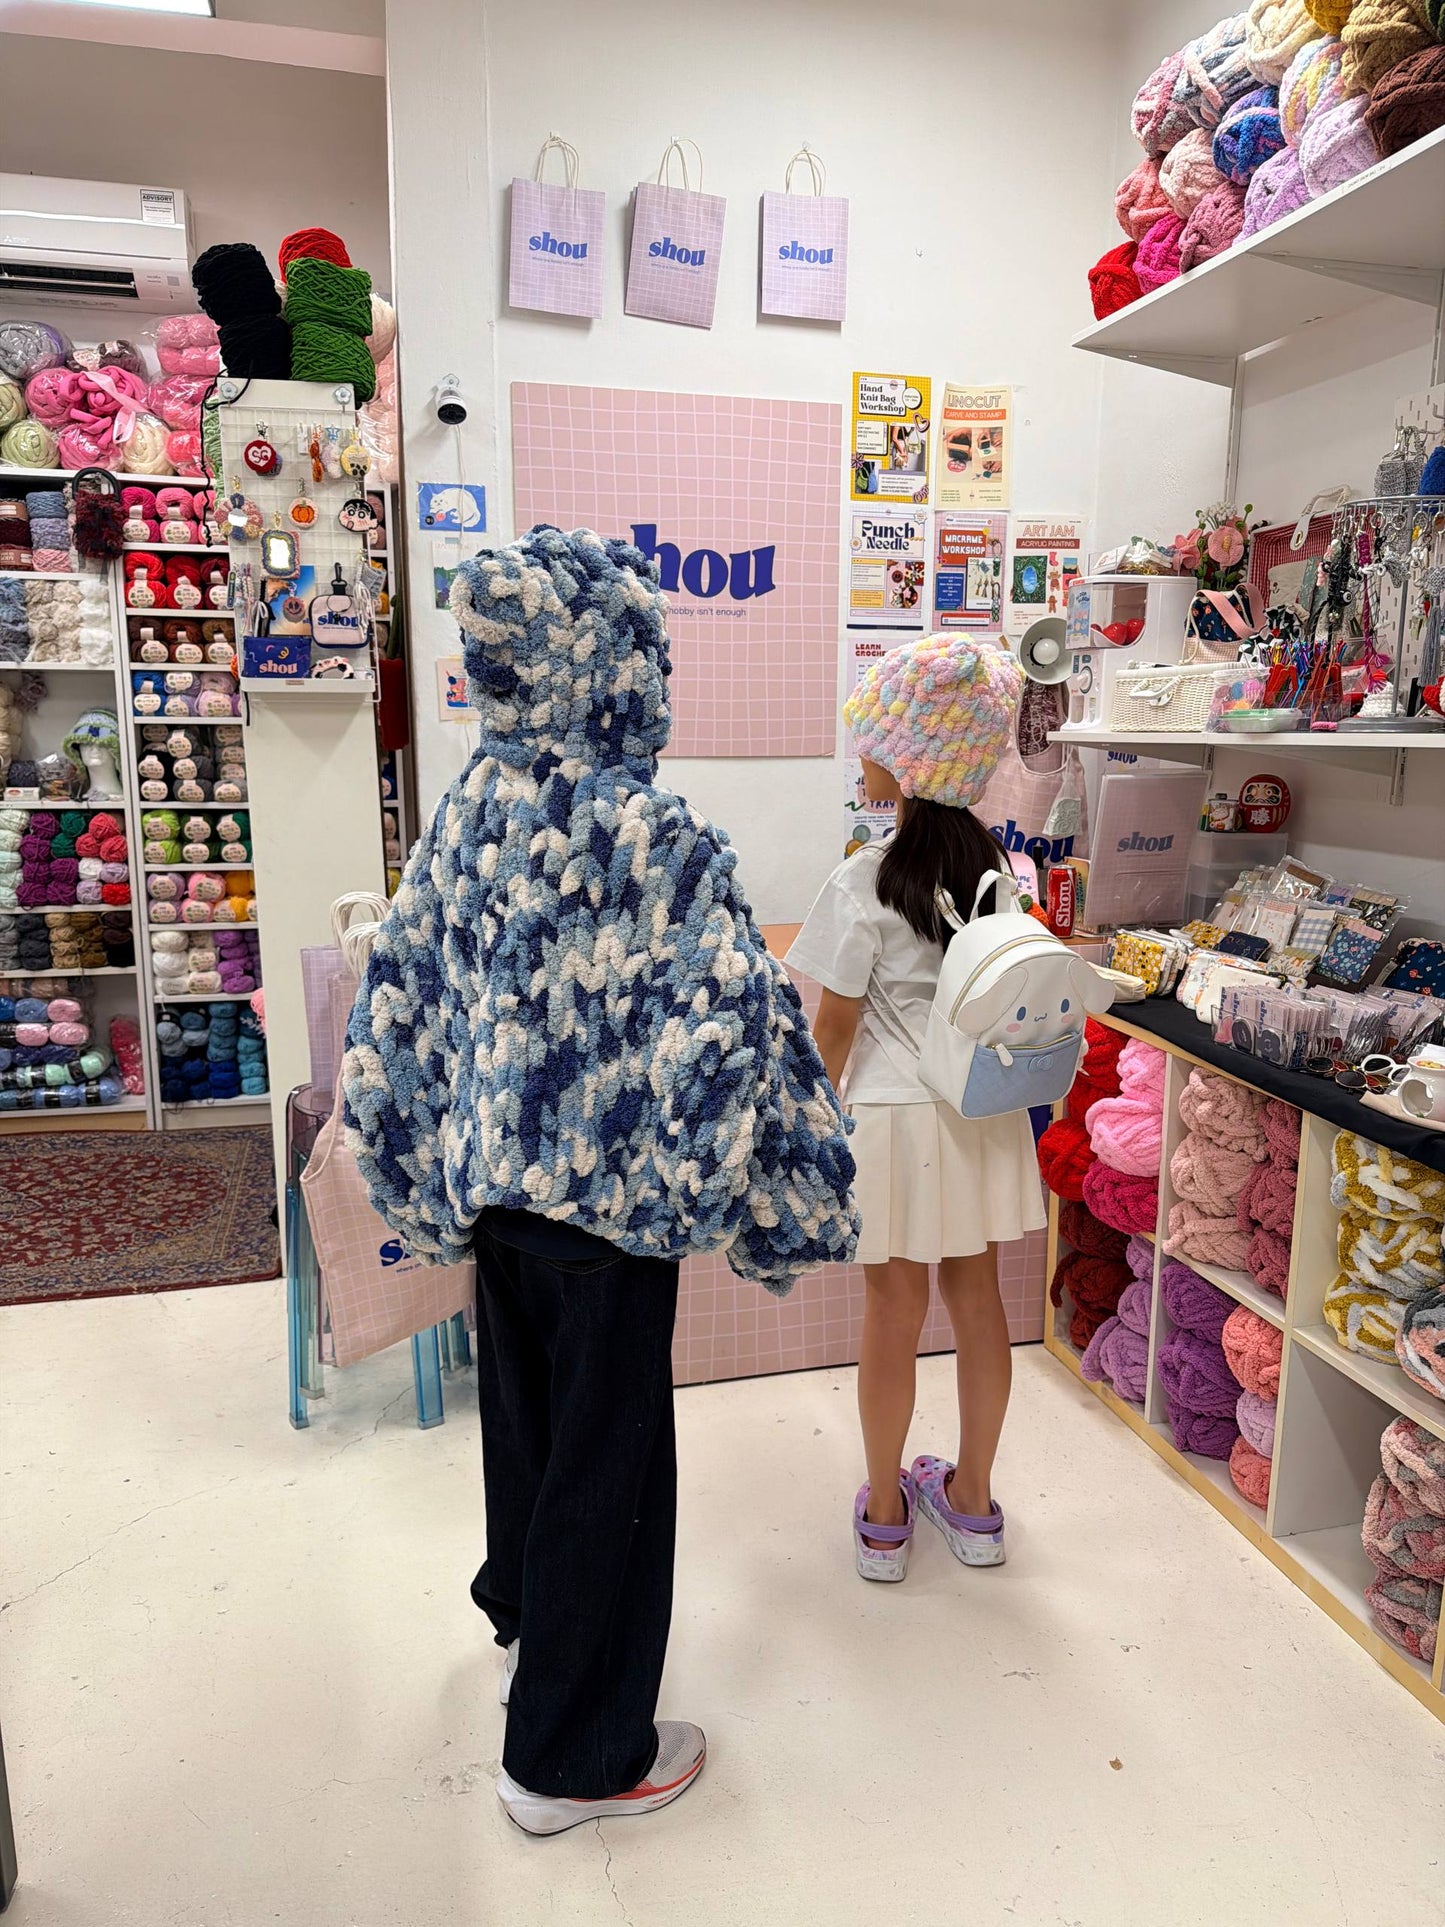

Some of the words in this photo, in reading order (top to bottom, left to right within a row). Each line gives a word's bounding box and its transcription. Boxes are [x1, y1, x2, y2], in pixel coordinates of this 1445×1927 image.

[529, 231, 588, 260] shou
[648, 236, 706, 267] shou
[778, 240, 834, 265] shou
[860, 384, 883, 393] Hand
[860, 393, 879, 401] Knit
[880, 394, 896, 405] Bag
[860, 402, 904, 414] Workshop
[965, 411, 978, 419] AND
[979, 411, 1002, 419] STAMP
[252, 450, 269, 463] SG
[861, 520, 916, 539] Punch
[1023, 525, 1048, 537] ART
[1049, 525, 1075, 537] JAM
[866, 536, 910, 551] Needle
[945, 534, 983, 544] MACRAME
[1021, 540, 1047, 548] ACRYLIC
[942, 545, 986, 555] WORKSHOP
[630, 523, 777, 601] hou
[668, 606, 694, 616] hobby
[715, 609, 746, 617] enough
[259, 659, 298, 674] shou
[869, 800, 895, 809] TRAY
[1250, 807, 1270, 826] 勝
[1116, 831, 1175, 853] shou
[1056, 879, 1073, 928] Shou
